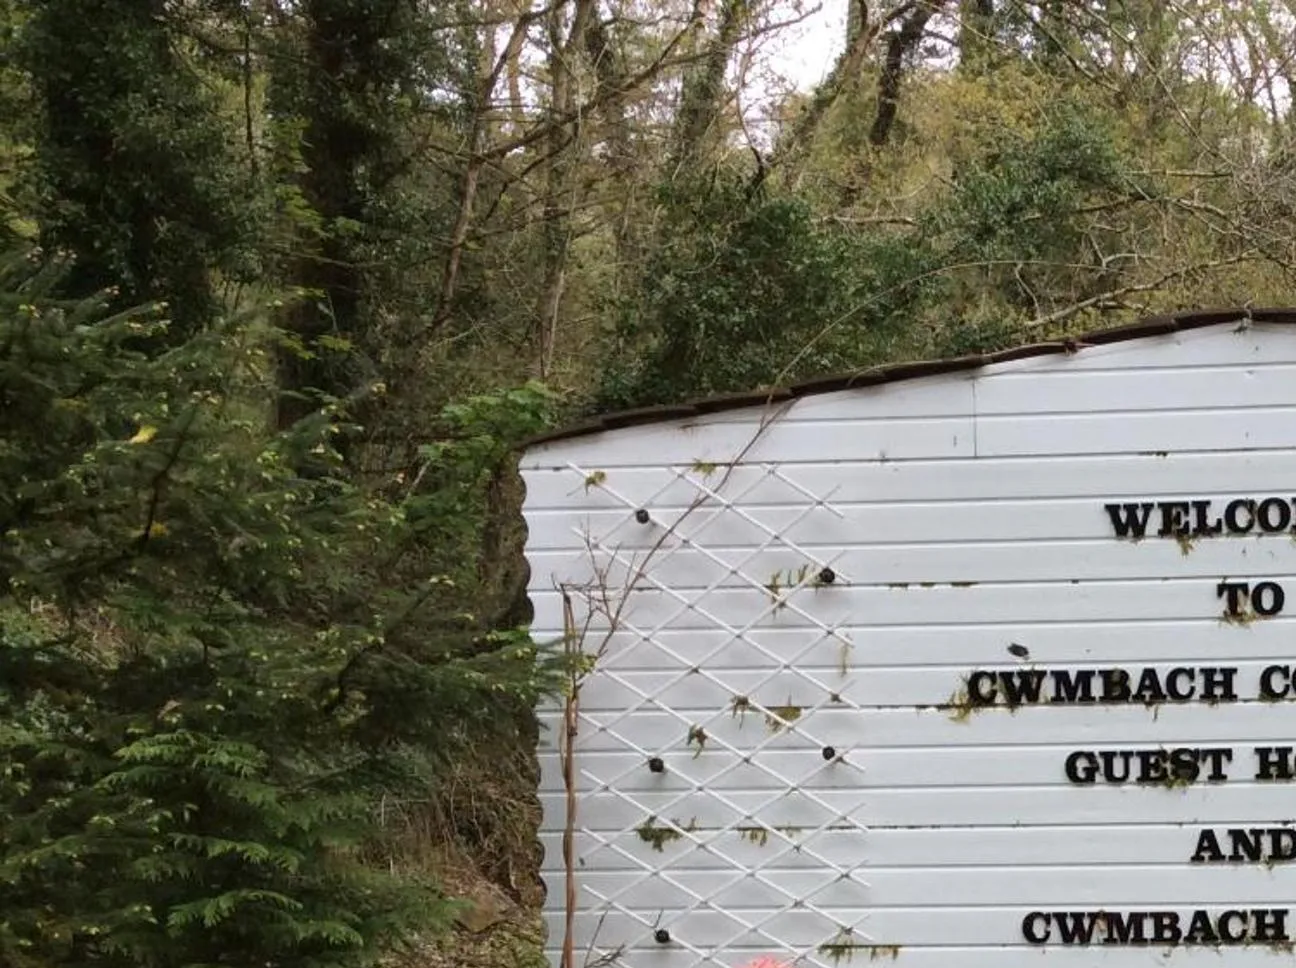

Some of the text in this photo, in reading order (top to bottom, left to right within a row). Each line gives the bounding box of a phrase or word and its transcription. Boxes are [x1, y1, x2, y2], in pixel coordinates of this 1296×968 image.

[1217, 581, 1285, 616] TO
[967, 667, 1237, 702] CWMBACH
[1065, 748, 1232, 784] GUEST
[1022, 909, 1289, 944] CWMBACH
